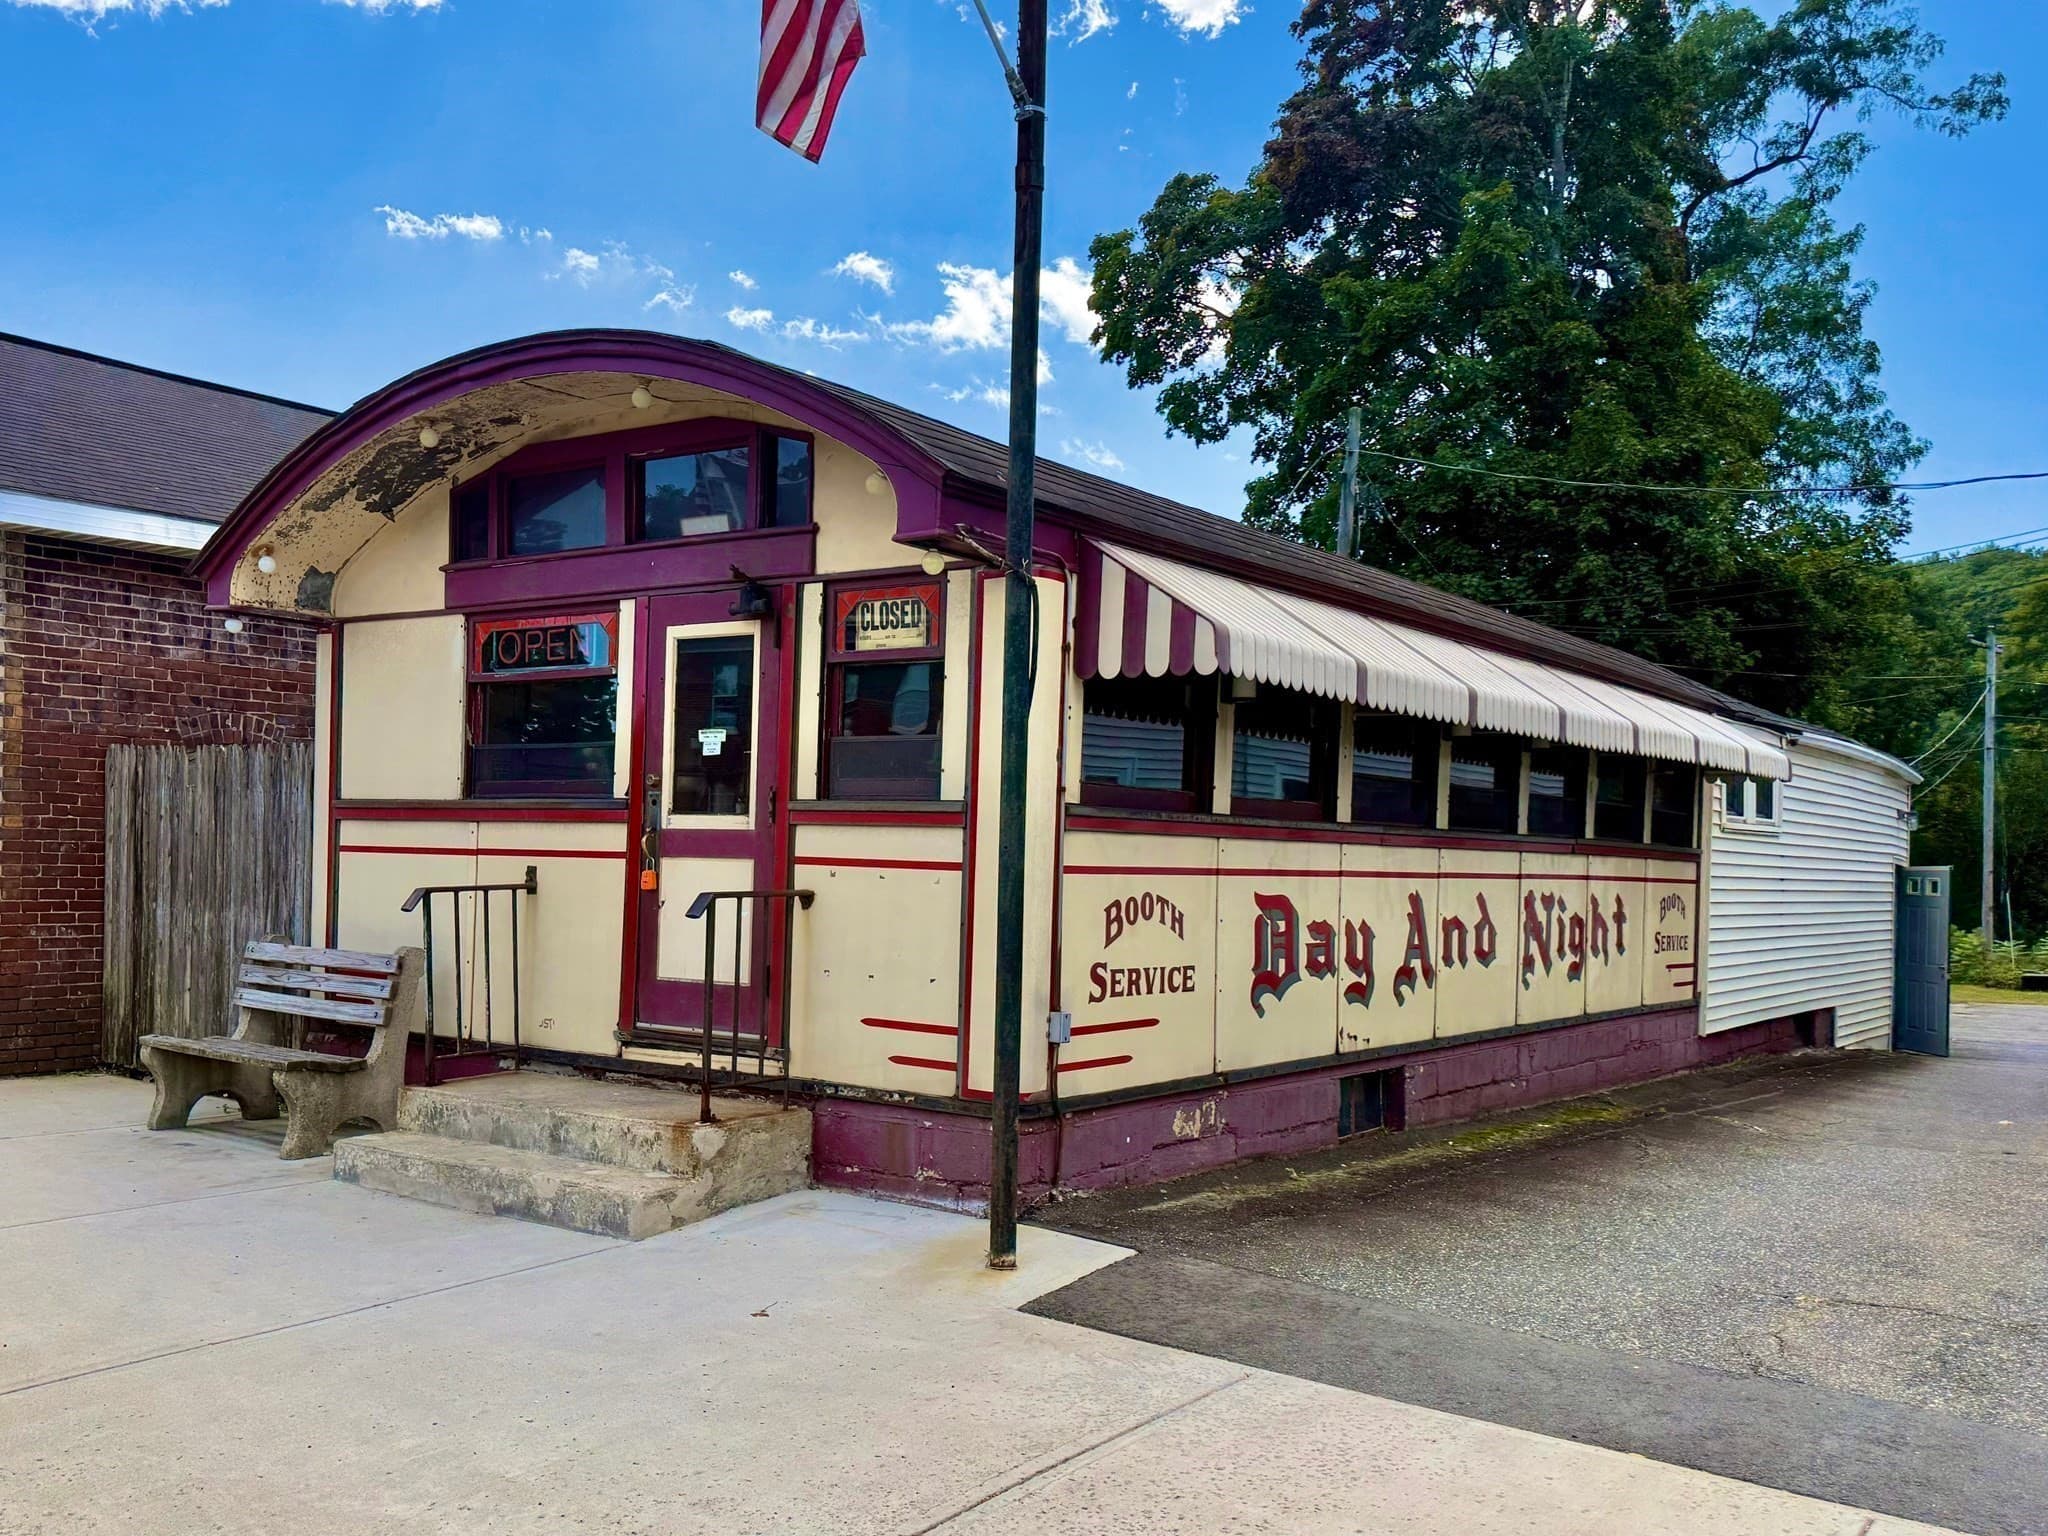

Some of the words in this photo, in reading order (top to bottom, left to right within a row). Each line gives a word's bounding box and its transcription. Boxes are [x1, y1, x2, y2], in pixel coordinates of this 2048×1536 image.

[860, 600, 921, 631] CLOSED
[498, 626, 590, 665] OPEN
[1104, 891, 1185, 949] BOOTH
[1660, 892, 1686, 923] BOOTH
[1250, 891, 1377, 1019] Day
[1393, 889, 1498, 1007] And
[1521, 889, 1627, 991] Night
[1654, 931, 1689, 954] SERVICE
[1088, 961, 1195, 1004] SERVICE
